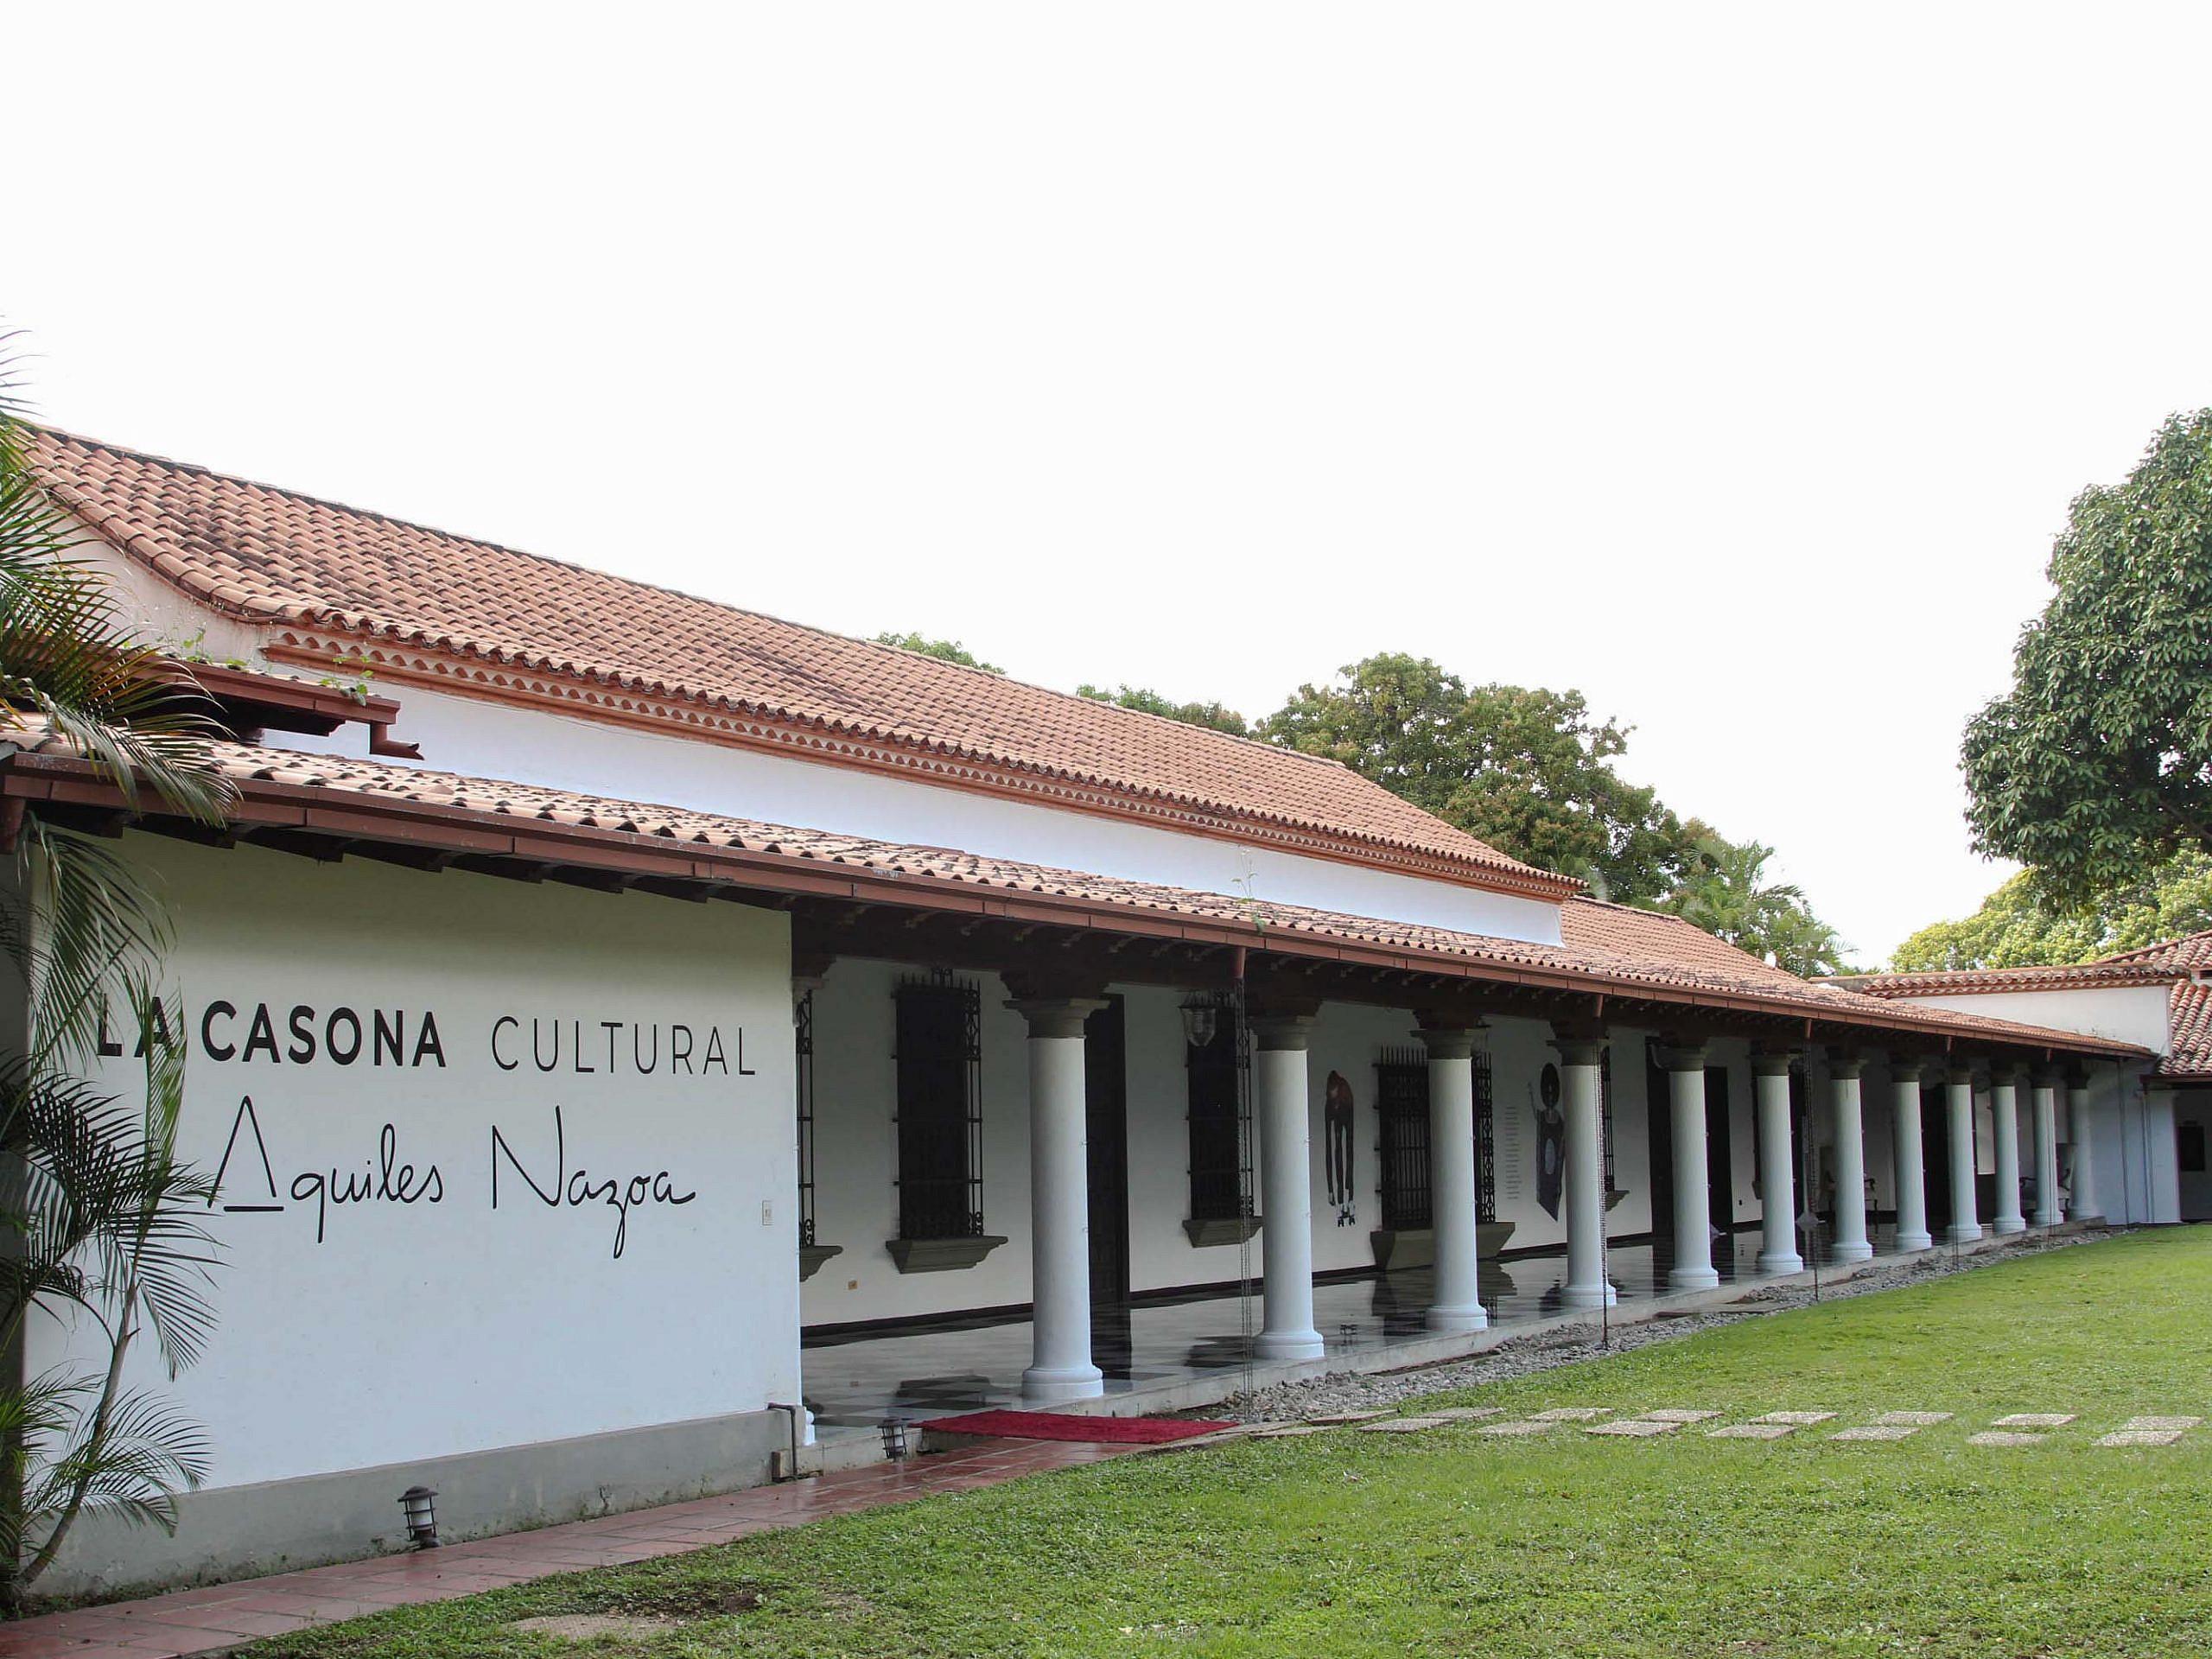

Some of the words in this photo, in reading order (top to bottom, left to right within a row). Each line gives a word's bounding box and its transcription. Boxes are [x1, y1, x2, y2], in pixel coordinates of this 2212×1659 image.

[98, 994, 177, 1058] LA
[201, 1000, 447, 1069] CASONA
[492, 1015, 757, 1077] CULTURAL
[207, 1095, 443, 1244] Aquiles
[492, 1105, 697, 1259] Nazoa
